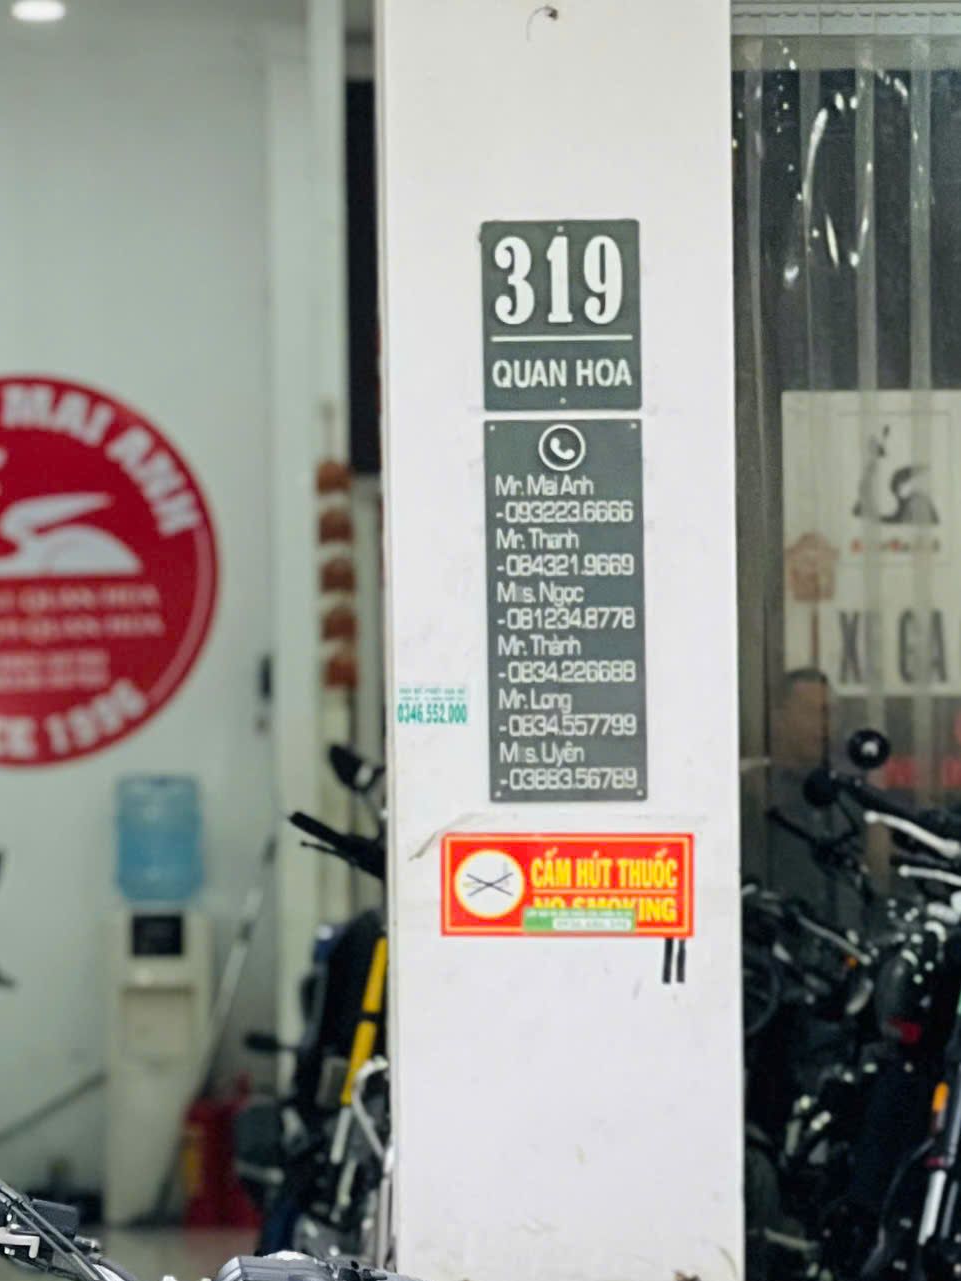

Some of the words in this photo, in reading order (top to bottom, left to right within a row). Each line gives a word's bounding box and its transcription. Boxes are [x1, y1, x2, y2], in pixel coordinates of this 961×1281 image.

[495, 236, 622, 325] 319
[492, 359, 567, 388] QUAN
[576, 358, 632, 387] HOA
[495, 474, 525, 496] Mr.
[527, 474, 558, 496] Mai
[560, 474, 594, 496] Anh
[496, 527, 526, 549] Mr.
[498, 634, 527, 656] Mr.
[499, 688, 529, 710] Mr.
[530, 688, 572, 713] Long
[541, 741, 584, 767] Uyên
[530, 847, 571, 888] CẤM
[575, 851, 613, 888] HÚT
[616, 848, 678, 888] THUỐC
